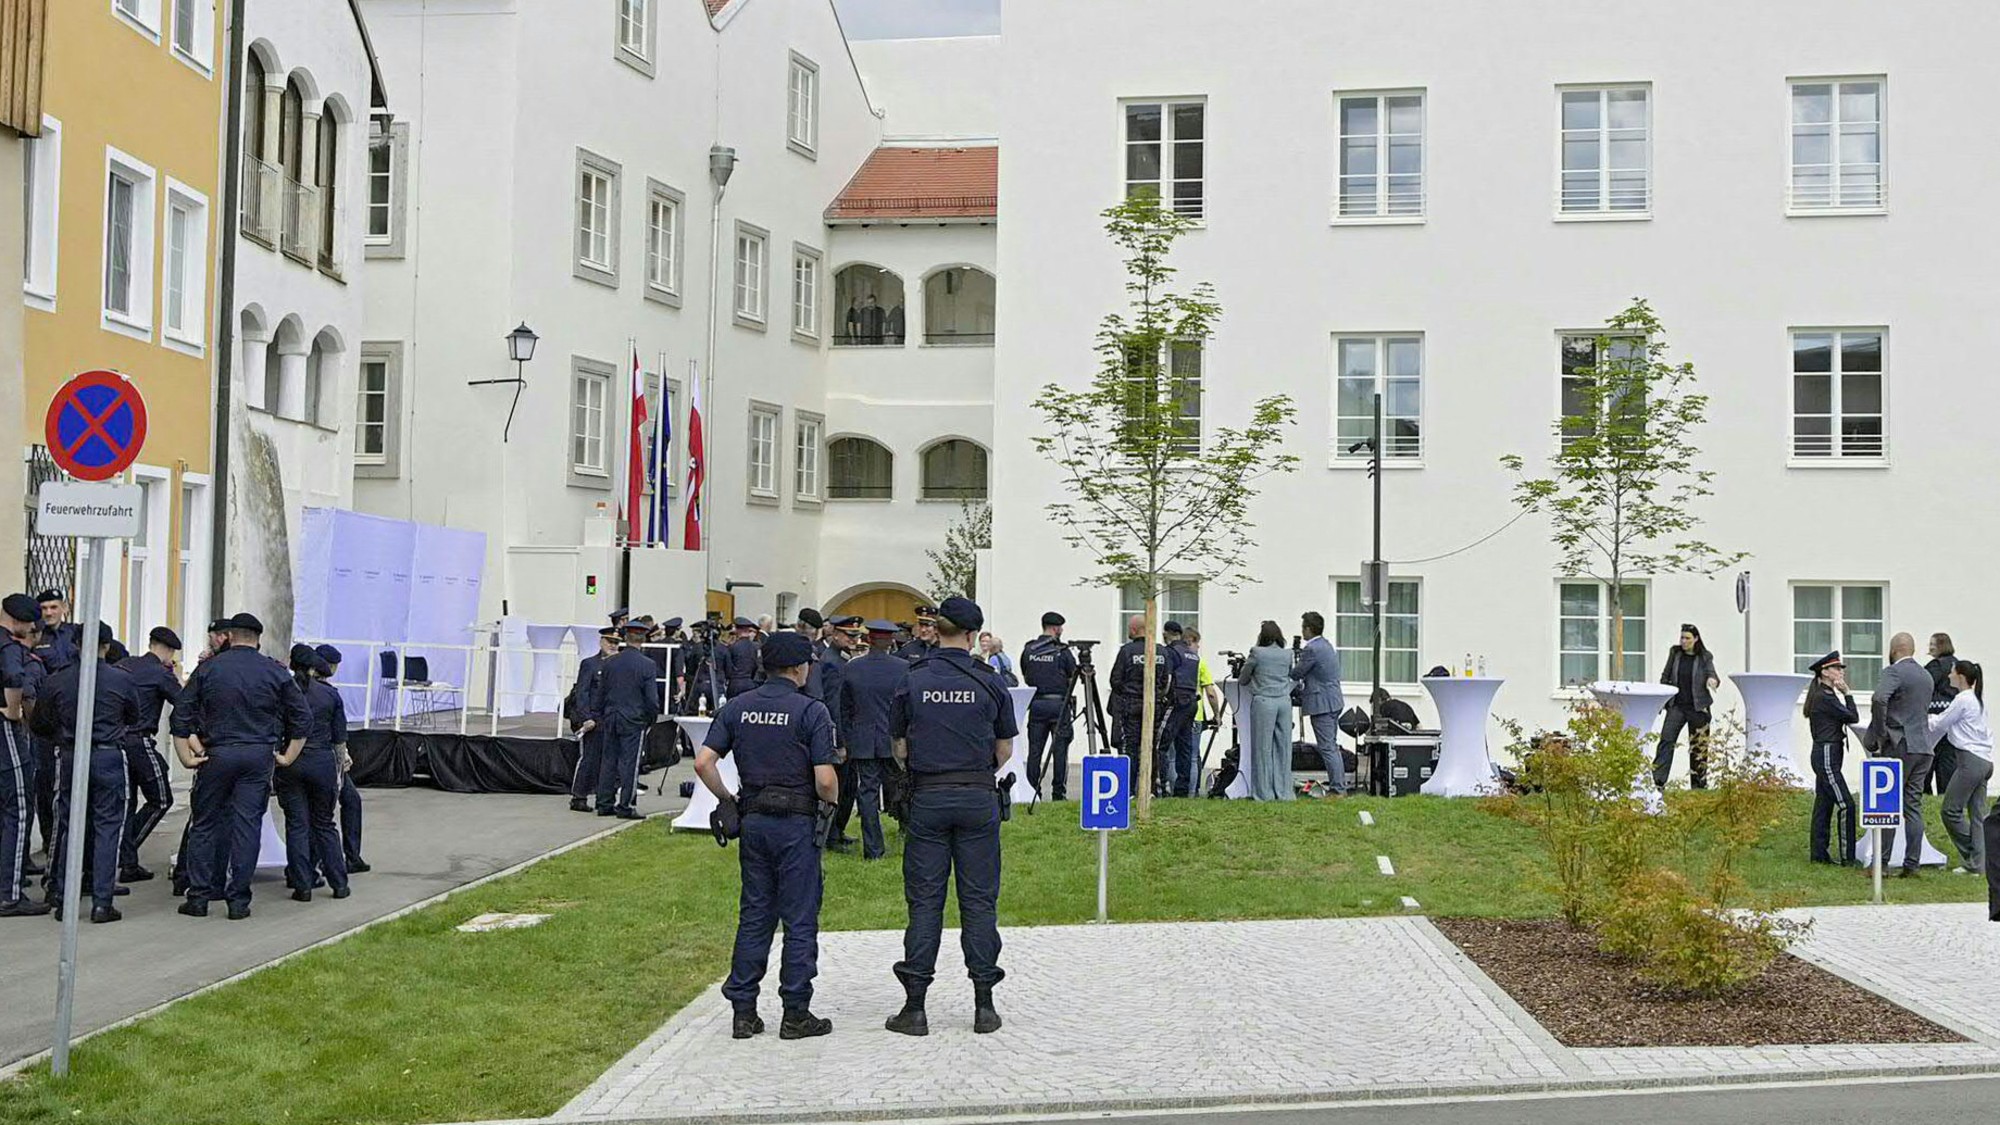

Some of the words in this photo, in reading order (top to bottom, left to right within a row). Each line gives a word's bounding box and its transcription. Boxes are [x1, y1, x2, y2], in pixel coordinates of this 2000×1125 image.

[45, 502, 133, 517] Feuerwehrzufahrt
[922, 690, 975, 703] POLIZEI
[741, 711, 789, 725] POLIZEI
[1091, 770, 1119, 815] P
[1869, 765, 1895, 809] P
